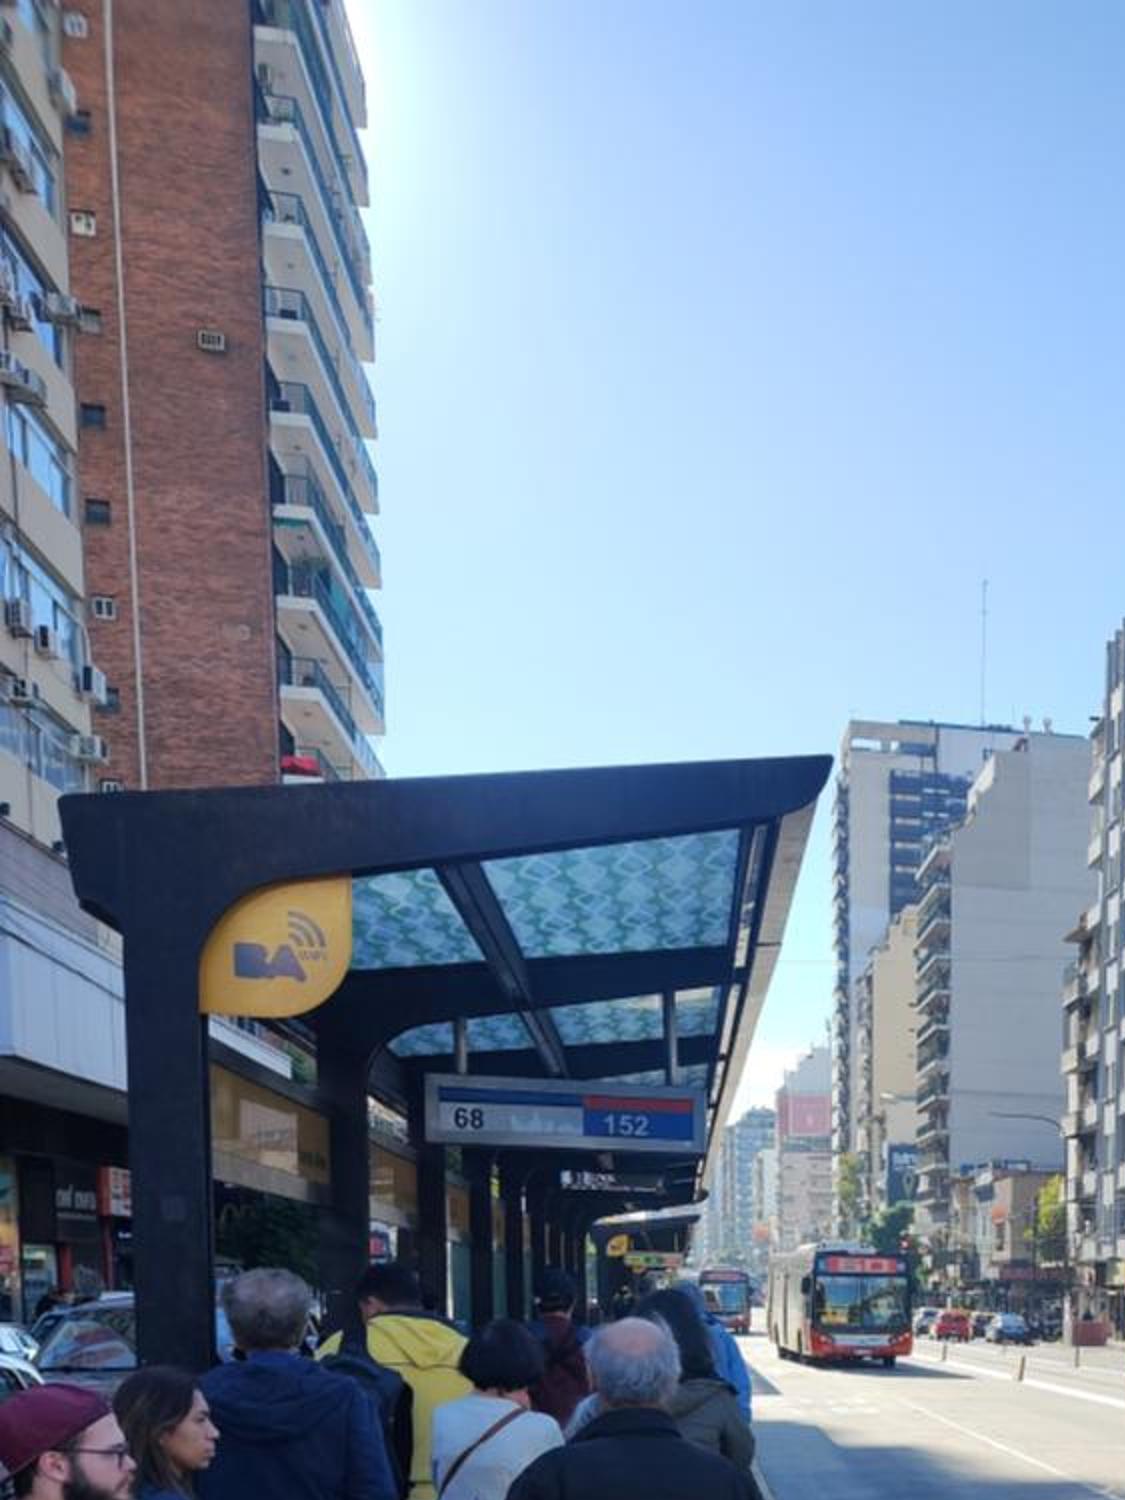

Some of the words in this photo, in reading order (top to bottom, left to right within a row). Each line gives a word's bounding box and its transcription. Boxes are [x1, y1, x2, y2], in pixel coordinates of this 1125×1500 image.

[233, 942, 307, 982] BA
[454, 1107, 484, 1130] 68
[604, 1114, 650, 1136] 152
